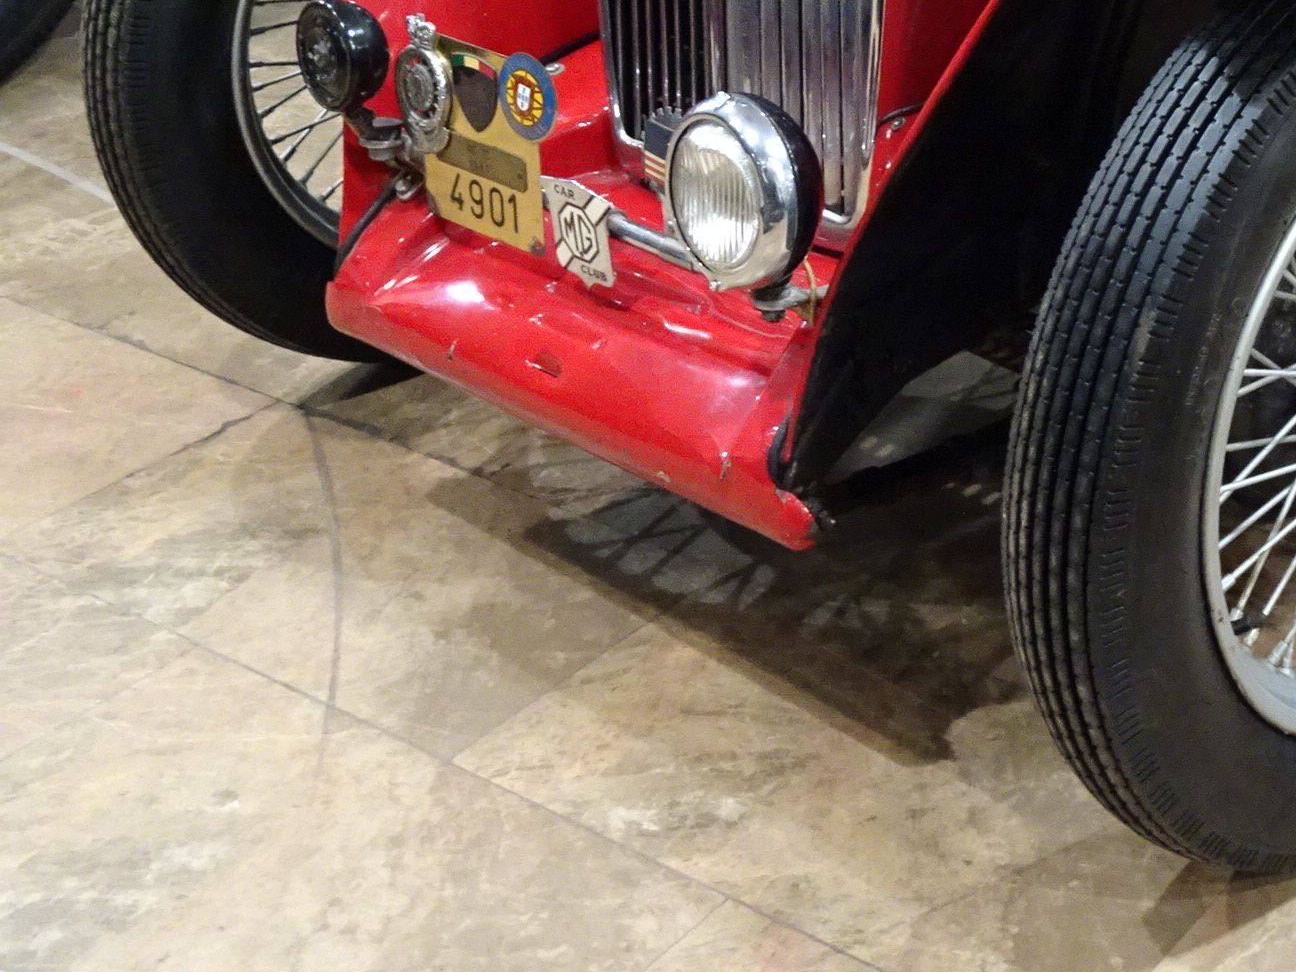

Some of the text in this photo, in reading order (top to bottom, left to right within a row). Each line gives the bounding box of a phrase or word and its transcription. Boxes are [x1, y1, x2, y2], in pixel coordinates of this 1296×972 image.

[450, 173, 518, 234] 4901
[553, 184, 575, 200] CAR
[564, 211, 593, 258] MG
[581, 264, 607, 282] CLUB
